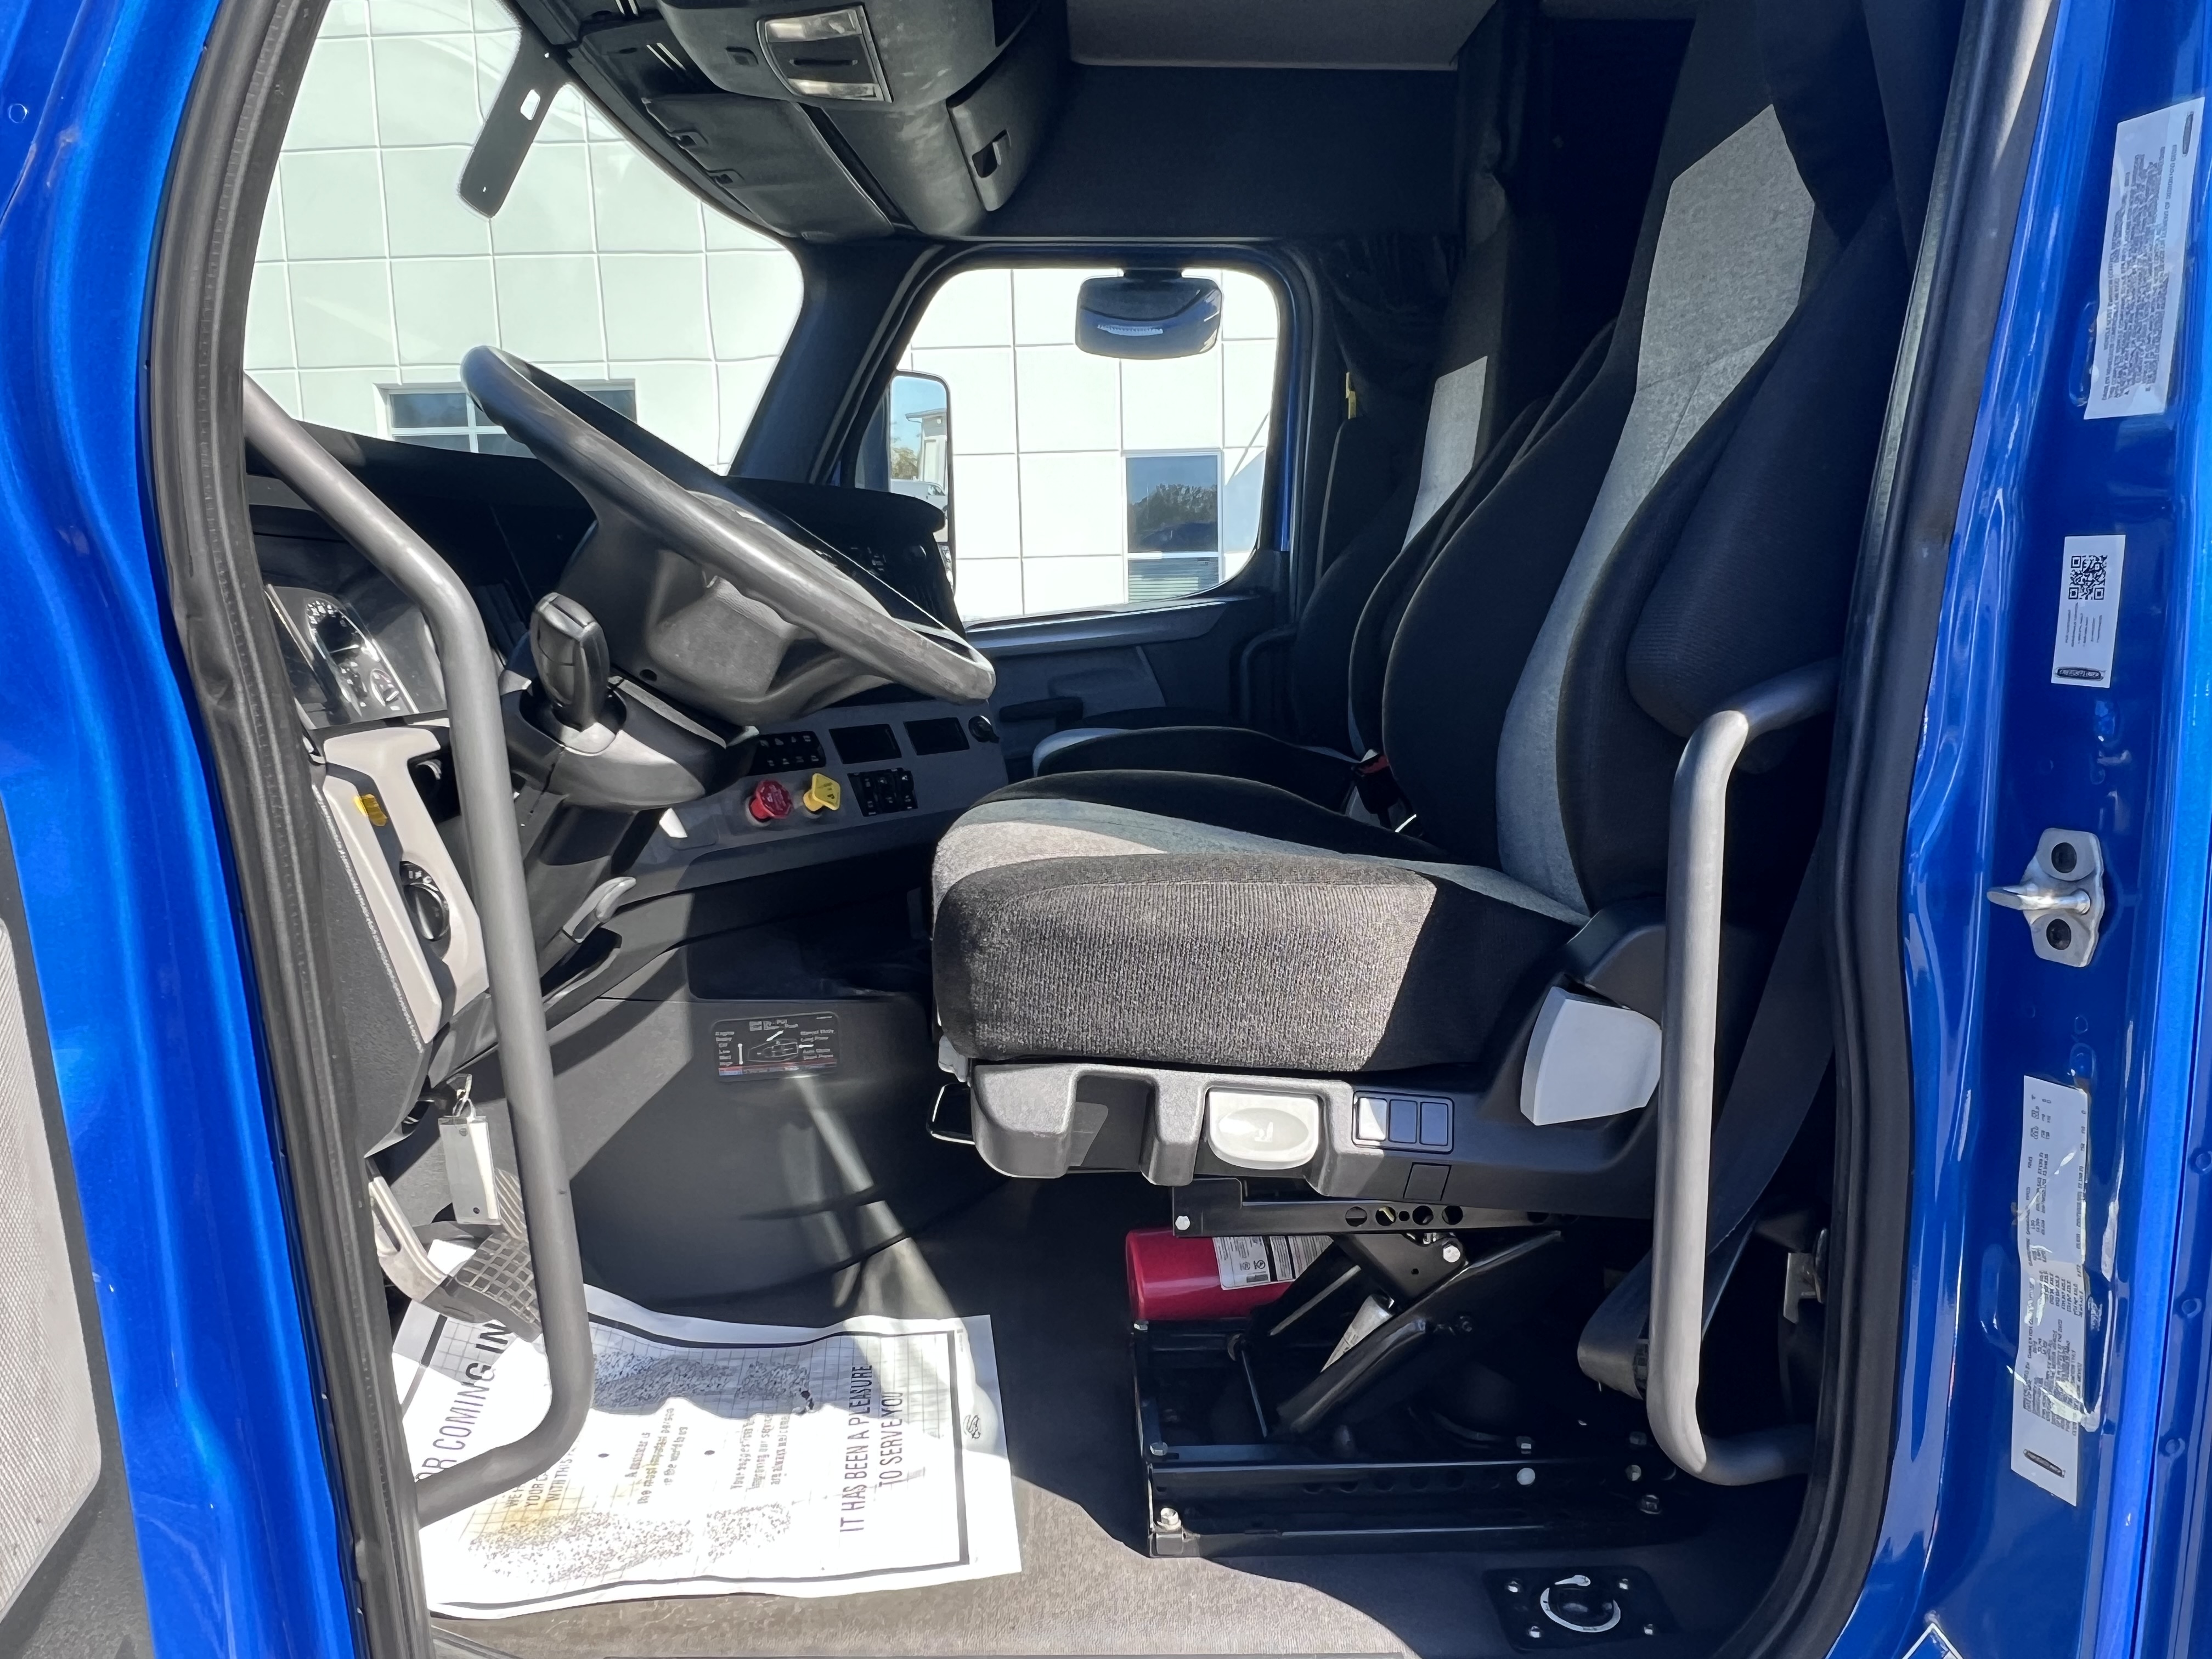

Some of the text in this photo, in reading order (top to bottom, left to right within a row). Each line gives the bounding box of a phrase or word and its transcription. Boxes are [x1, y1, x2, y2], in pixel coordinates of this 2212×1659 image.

[432, 1363, 496, 1450] COMING
[475, 1323, 511, 1354] IN
[840, 1365, 872, 1532] IT HAS BEEN A PLEASURE
[878, 1392, 903, 1487] TO SERVE YOU
[504, 1494, 522, 1508] WE
[526, 1483, 544, 1507] YOUR
[546, 1459, 572, 1502] WITH THIS
